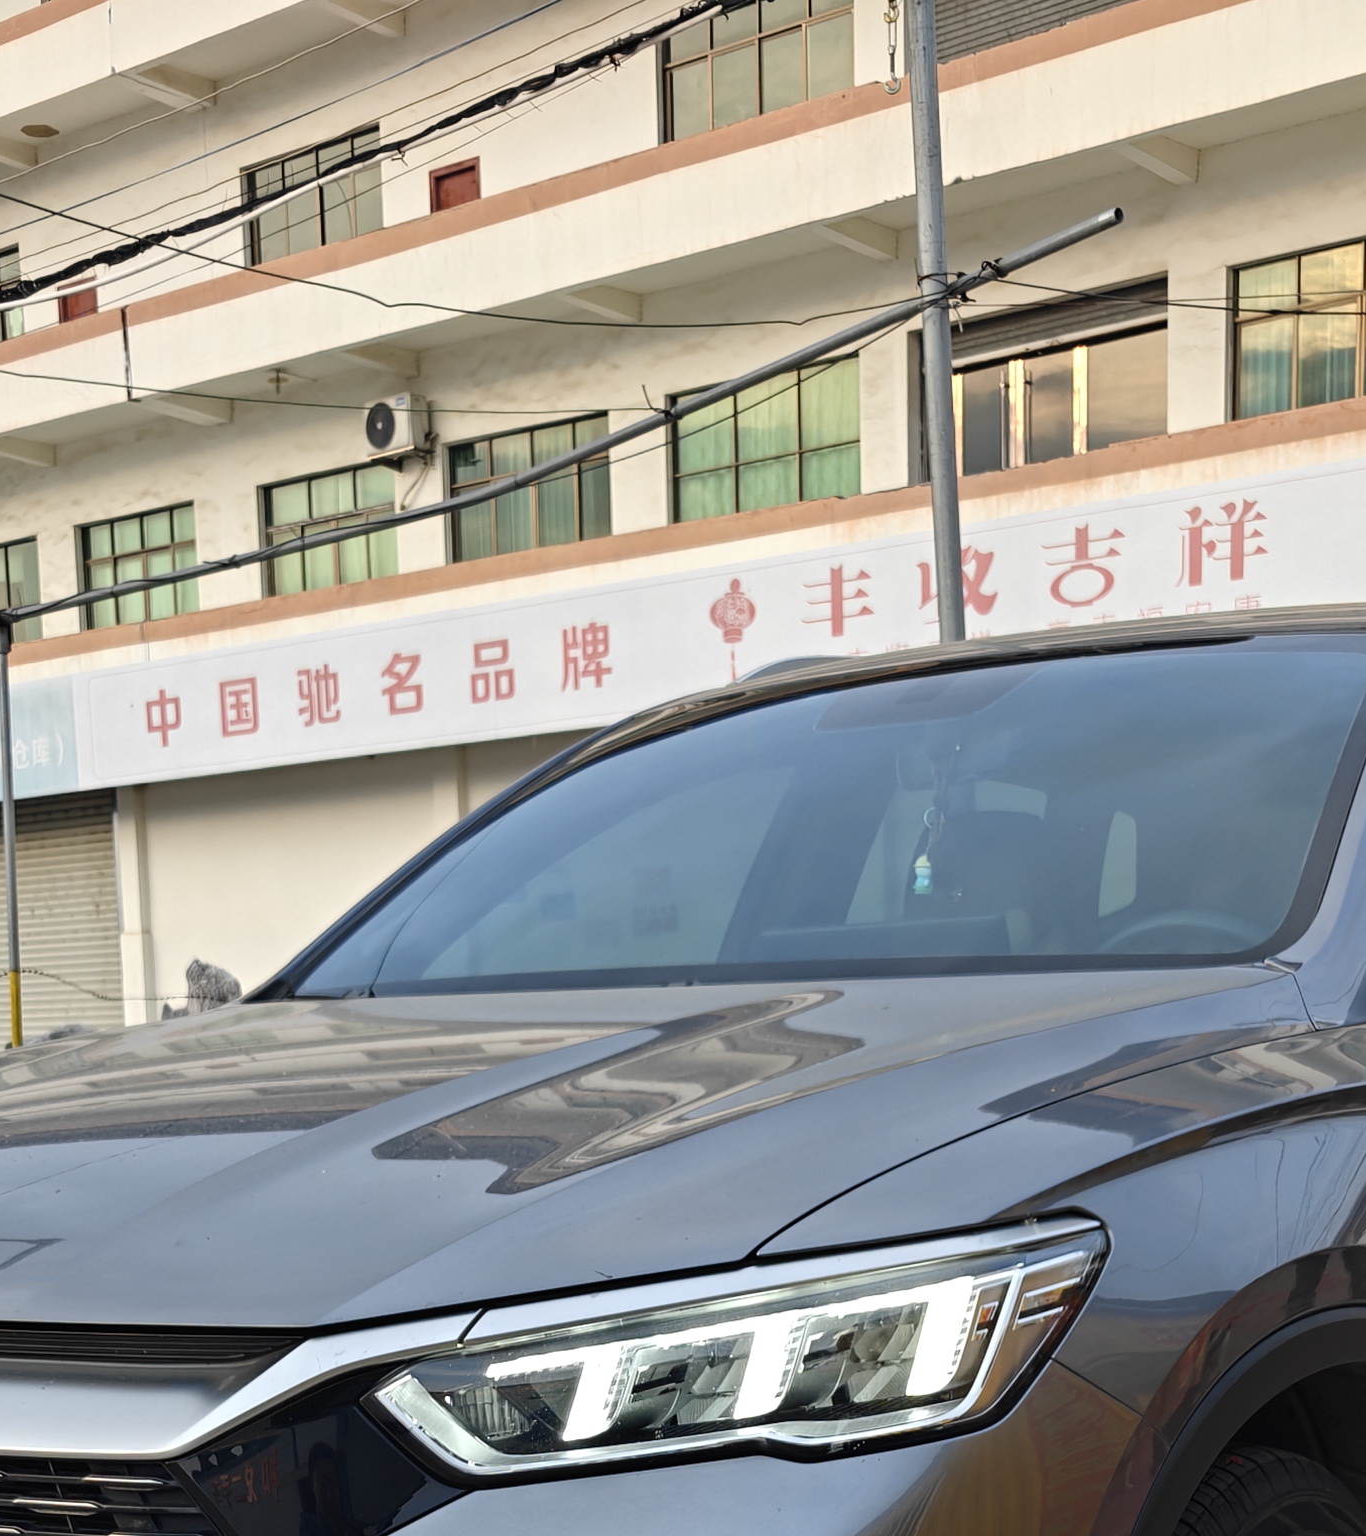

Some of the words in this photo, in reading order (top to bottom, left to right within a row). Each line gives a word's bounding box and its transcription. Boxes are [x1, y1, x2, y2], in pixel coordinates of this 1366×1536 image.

[145, 621, 612, 747] 中国驰名品牌
